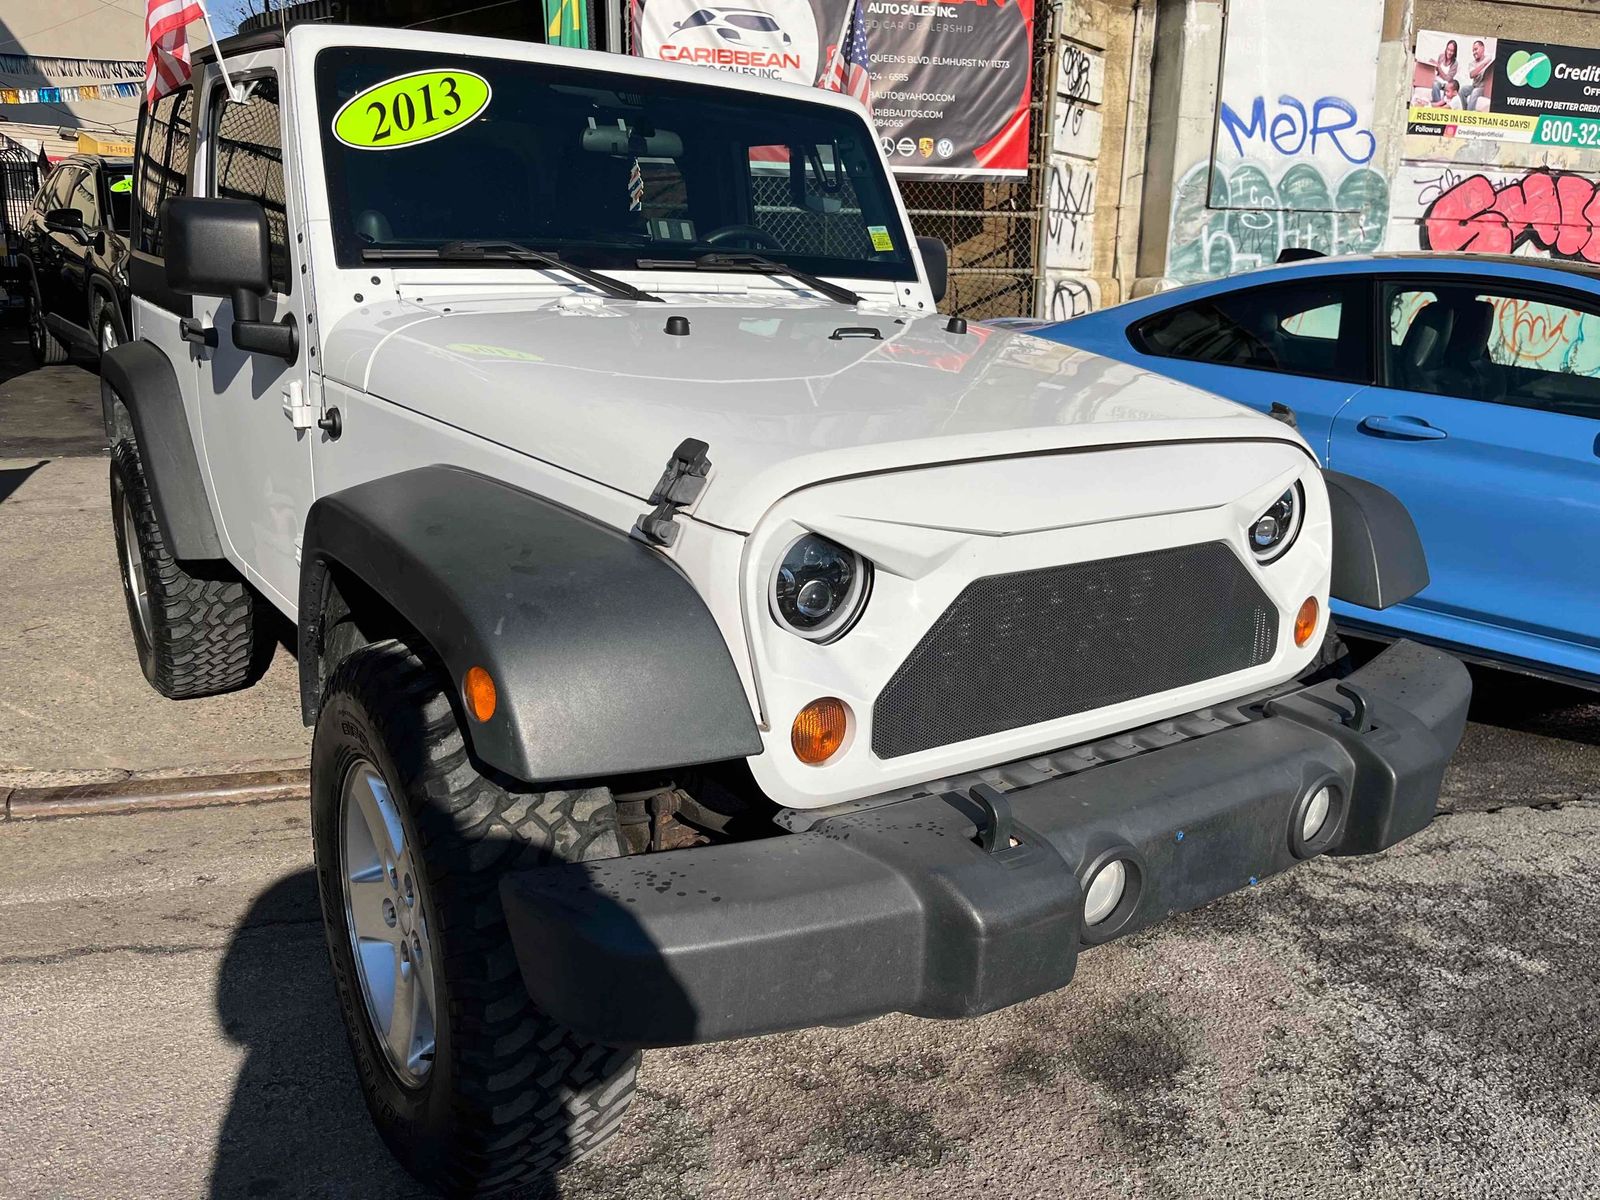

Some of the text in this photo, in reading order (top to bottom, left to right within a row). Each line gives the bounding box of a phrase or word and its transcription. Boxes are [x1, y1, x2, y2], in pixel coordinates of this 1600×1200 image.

[867, 3, 900, 15] AUTO
[900, 4, 935, 17] SALES
[937, 7, 958, 18] INC.
[883, 20, 904, 30] CAR
[908, 22, 974, 32] DELERSHIP
[659, 45, 800, 69] CARIBBEAN
[870, 54, 1010, 69] QUEENS BLVD. ELMHURST NY 11373
[758, 68, 782, 80] INC.
[888, 73, 909, 82] 6585
[1554, 63, 1600, 82] Credit
[366, 77, 461, 142] 2013
[1507, 97, 1525, 106] YOUR
[1526, 98, 1544, 108] PATH
[1544, 99, 1553, 109] TO
[1554, 101, 1579, 111] BETTER
[1416, 112, 1530, 129] RESULTS IN LESS THAN 45 DAYS!
